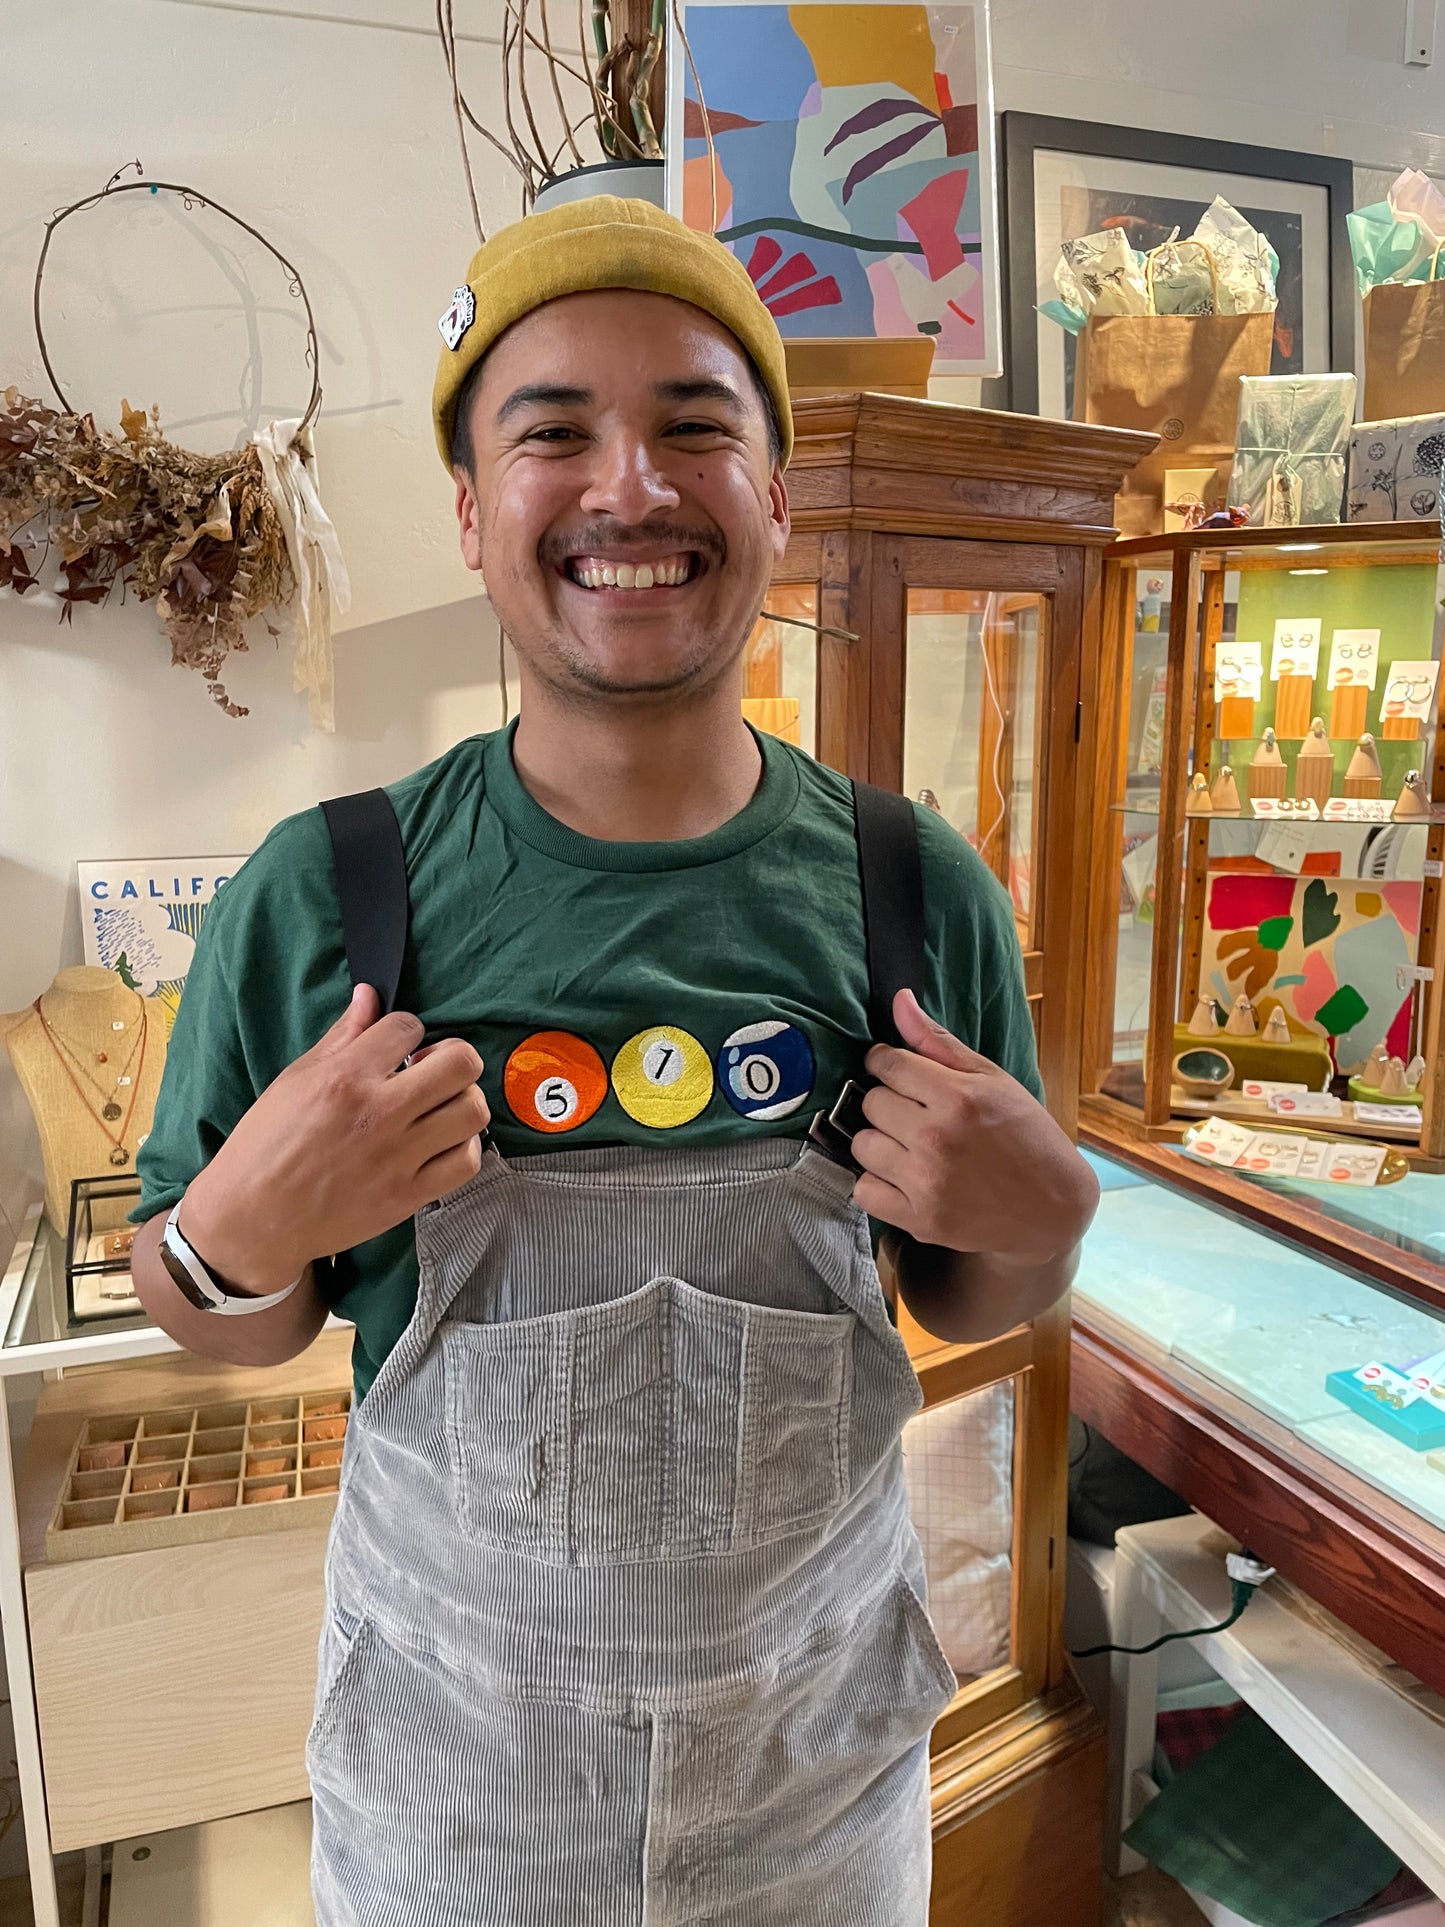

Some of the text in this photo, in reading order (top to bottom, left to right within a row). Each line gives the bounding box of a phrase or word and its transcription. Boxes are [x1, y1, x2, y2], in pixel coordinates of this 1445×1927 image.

[544, 1048, 774, 1118] 5 1 0
